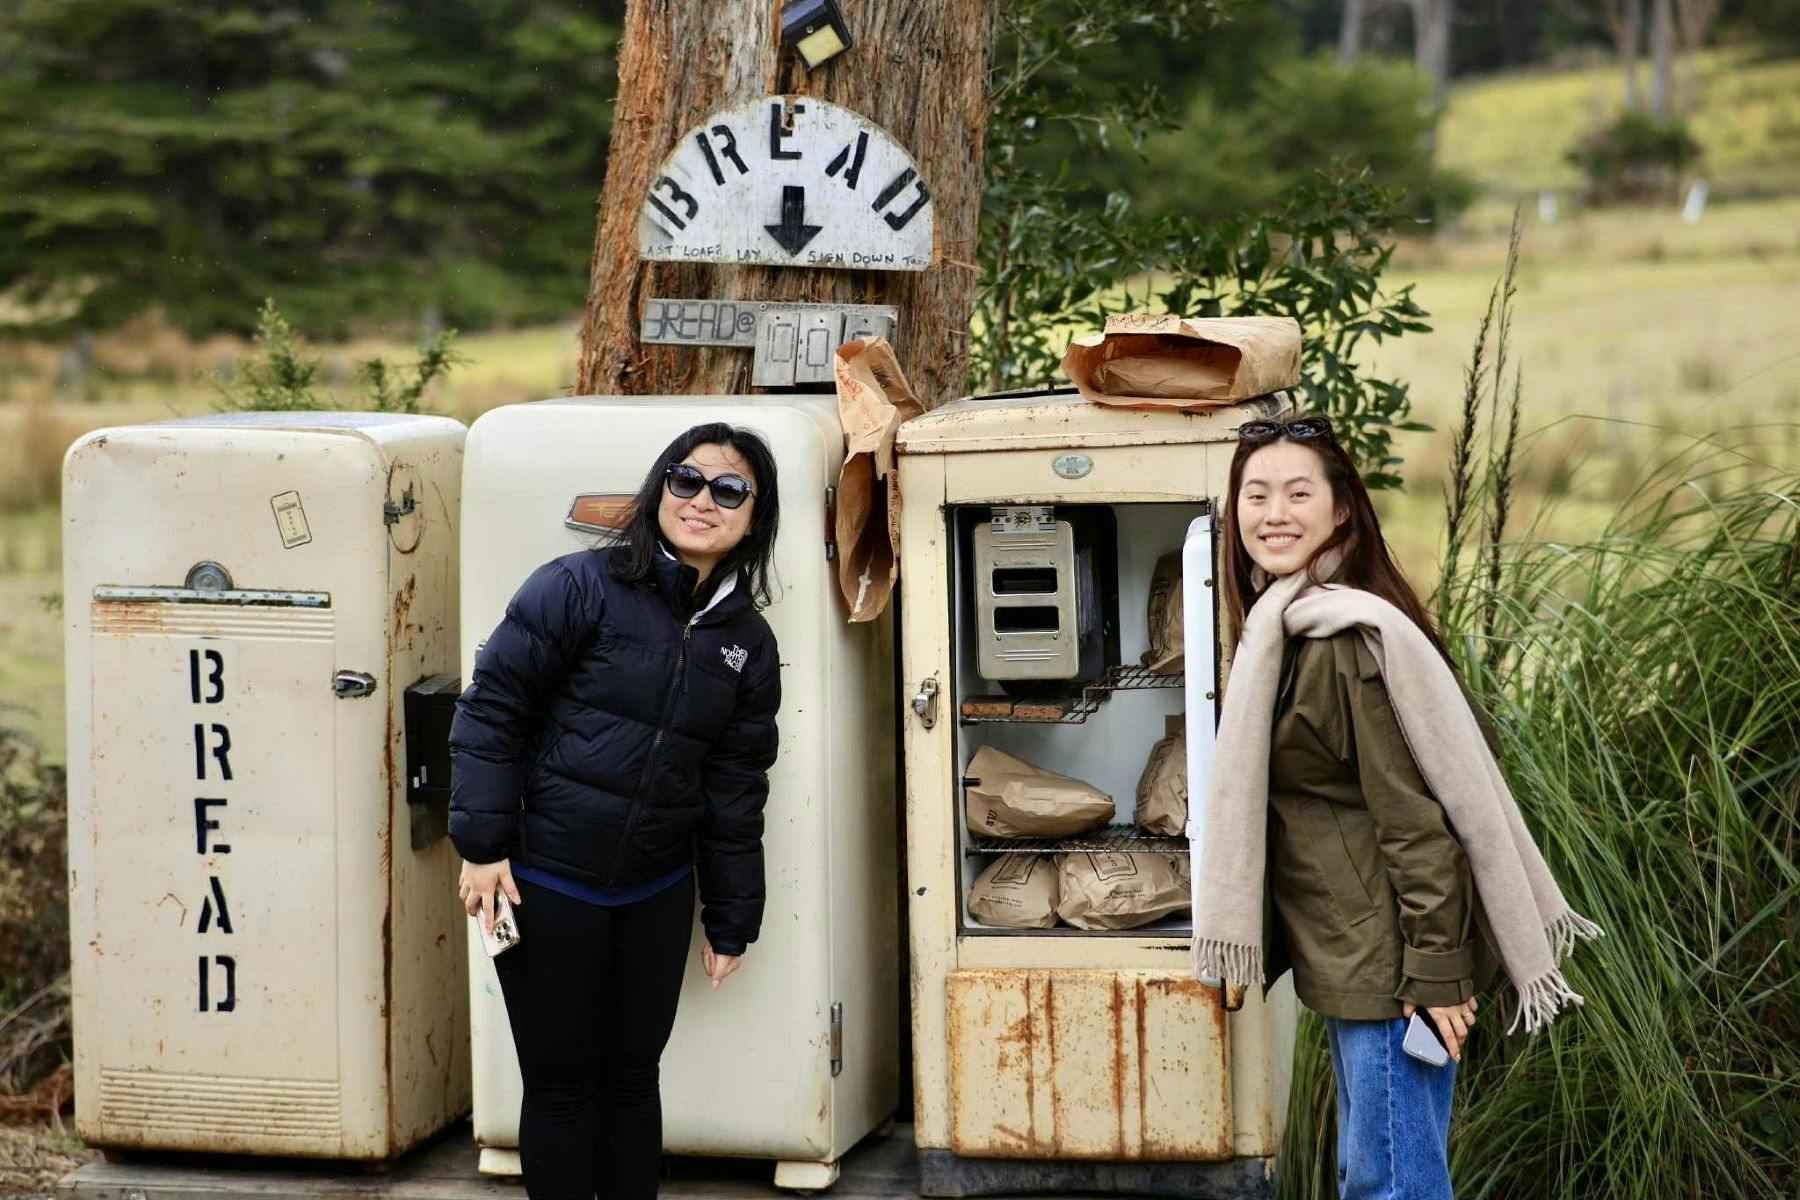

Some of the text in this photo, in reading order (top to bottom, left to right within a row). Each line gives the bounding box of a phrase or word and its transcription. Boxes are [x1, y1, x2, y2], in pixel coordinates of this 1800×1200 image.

[648, 103, 931, 232] BREAD
[852, 252, 894, 265] DOWN
[189, 648, 236, 1013] BREAD
